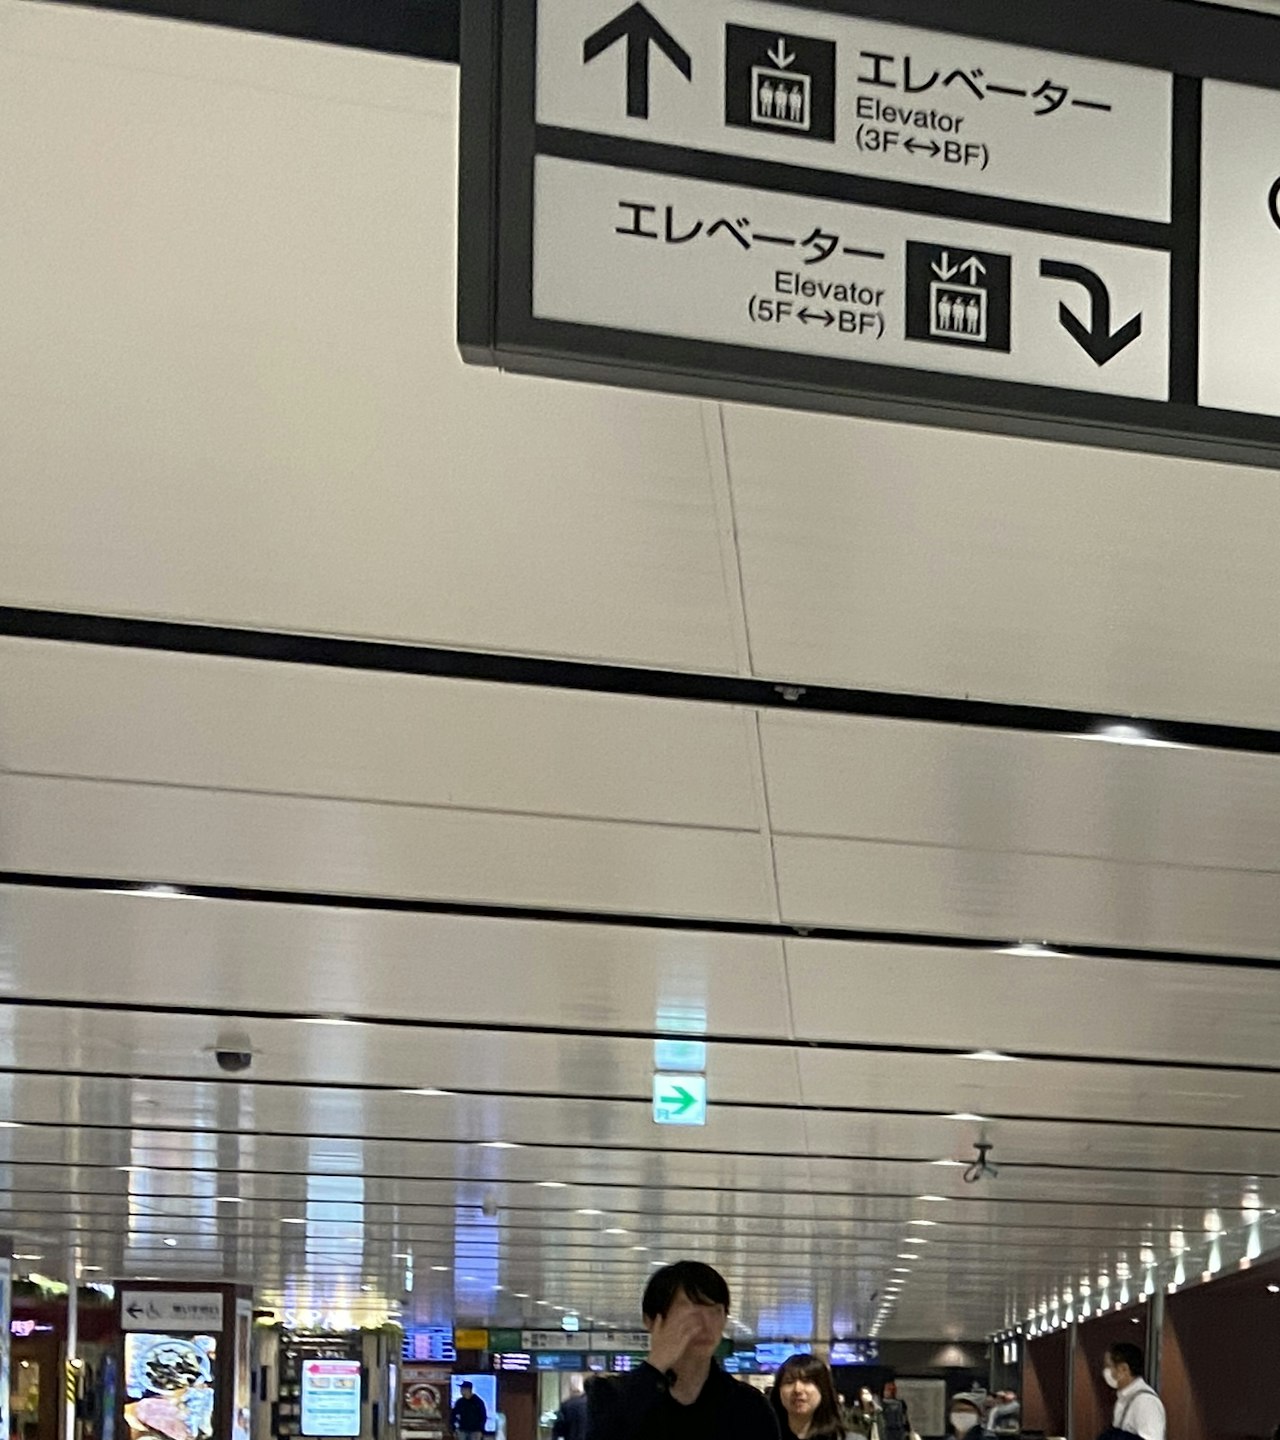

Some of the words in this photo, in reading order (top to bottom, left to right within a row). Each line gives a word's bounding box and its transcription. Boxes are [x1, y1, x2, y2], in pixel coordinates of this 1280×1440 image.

[856, 50, 1113, 119] エレベーター
[855, 96, 965, 135] Elevator
[614, 200, 886, 265] エレベーター
[773, 269, 886, 308] Elevator
